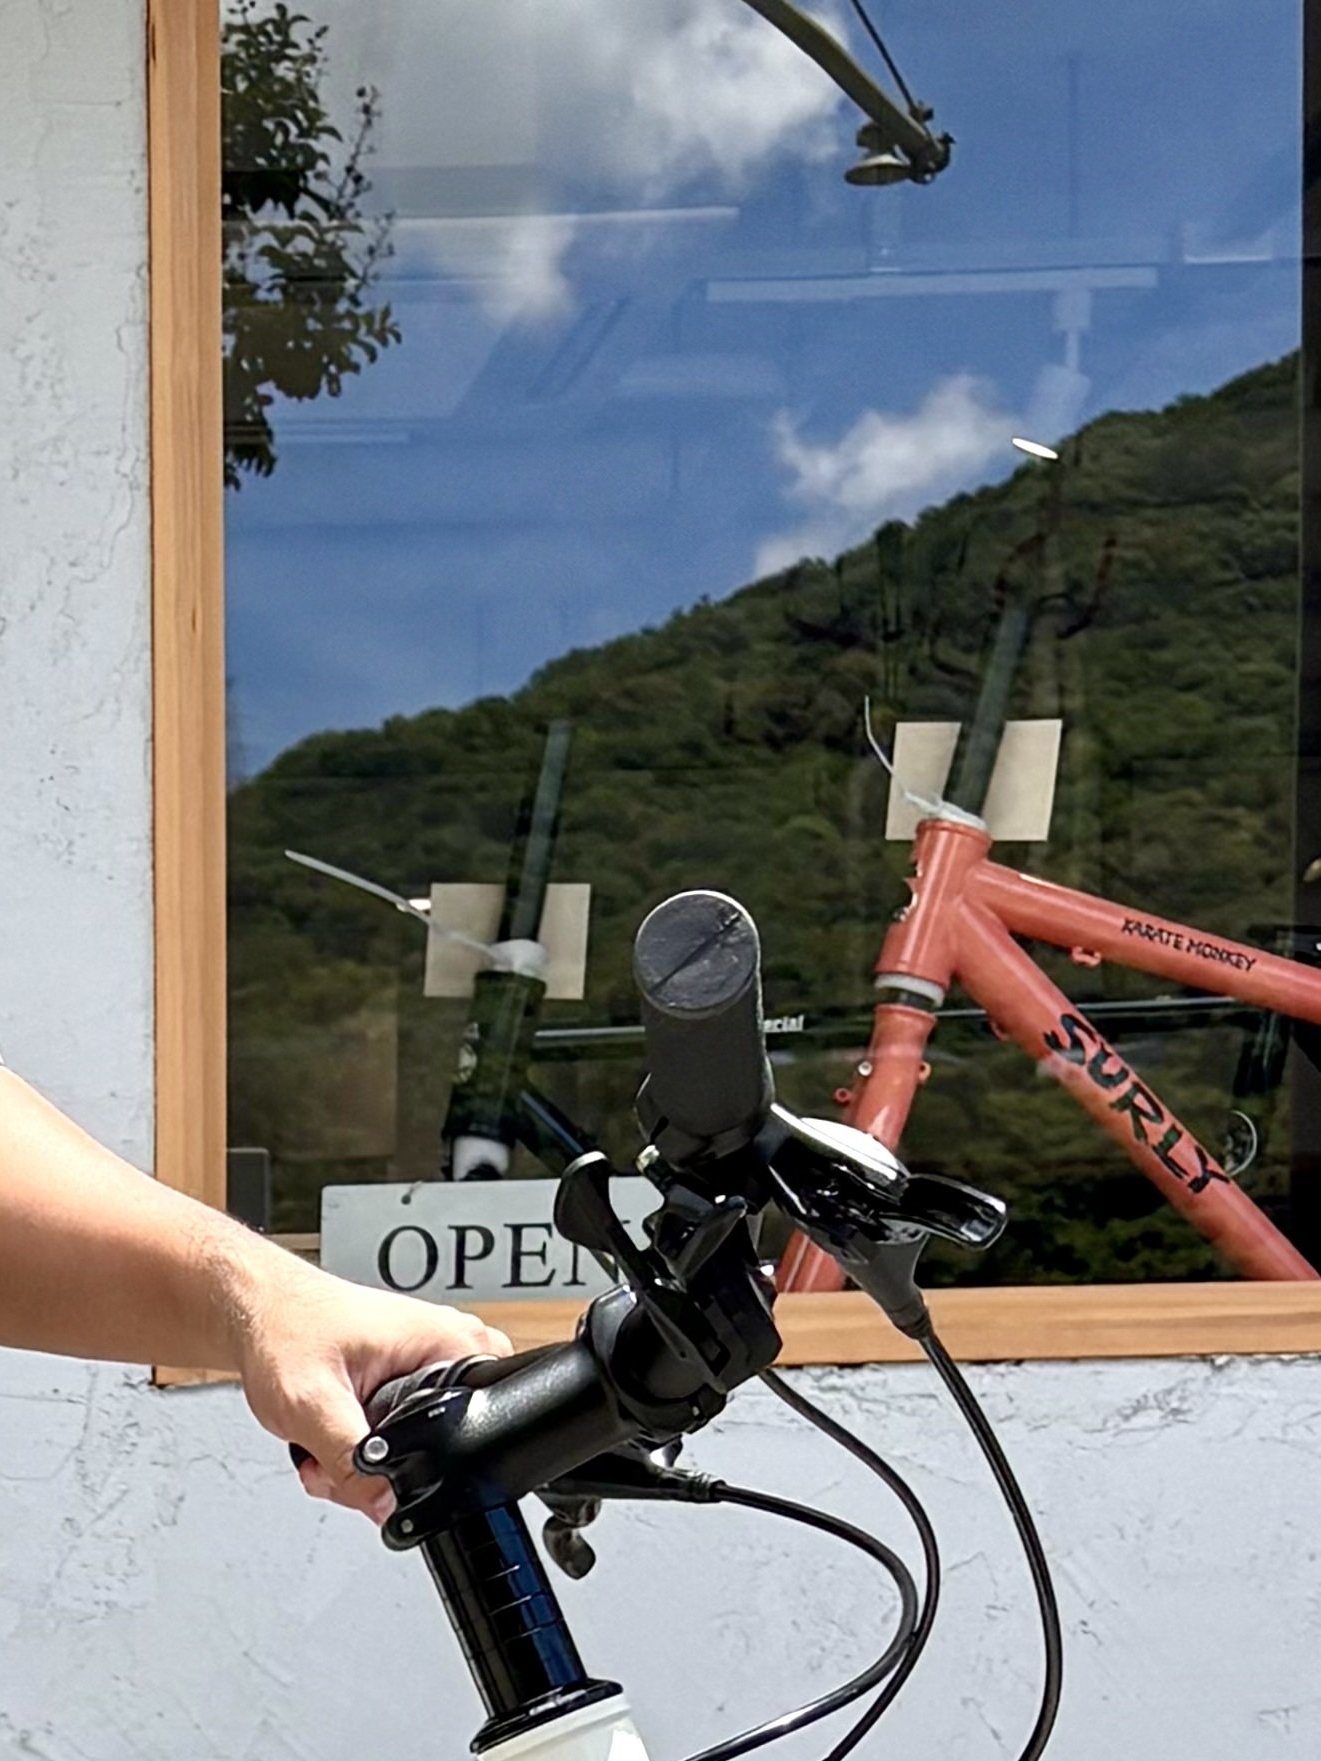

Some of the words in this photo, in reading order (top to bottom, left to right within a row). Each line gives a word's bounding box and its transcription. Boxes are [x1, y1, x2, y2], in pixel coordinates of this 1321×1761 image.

[1121, 918, 1184, 951] KARATE
[1186, 938, 1257, 973] MONKEY
[1043, 1013, 1231, 1194] SURLY
